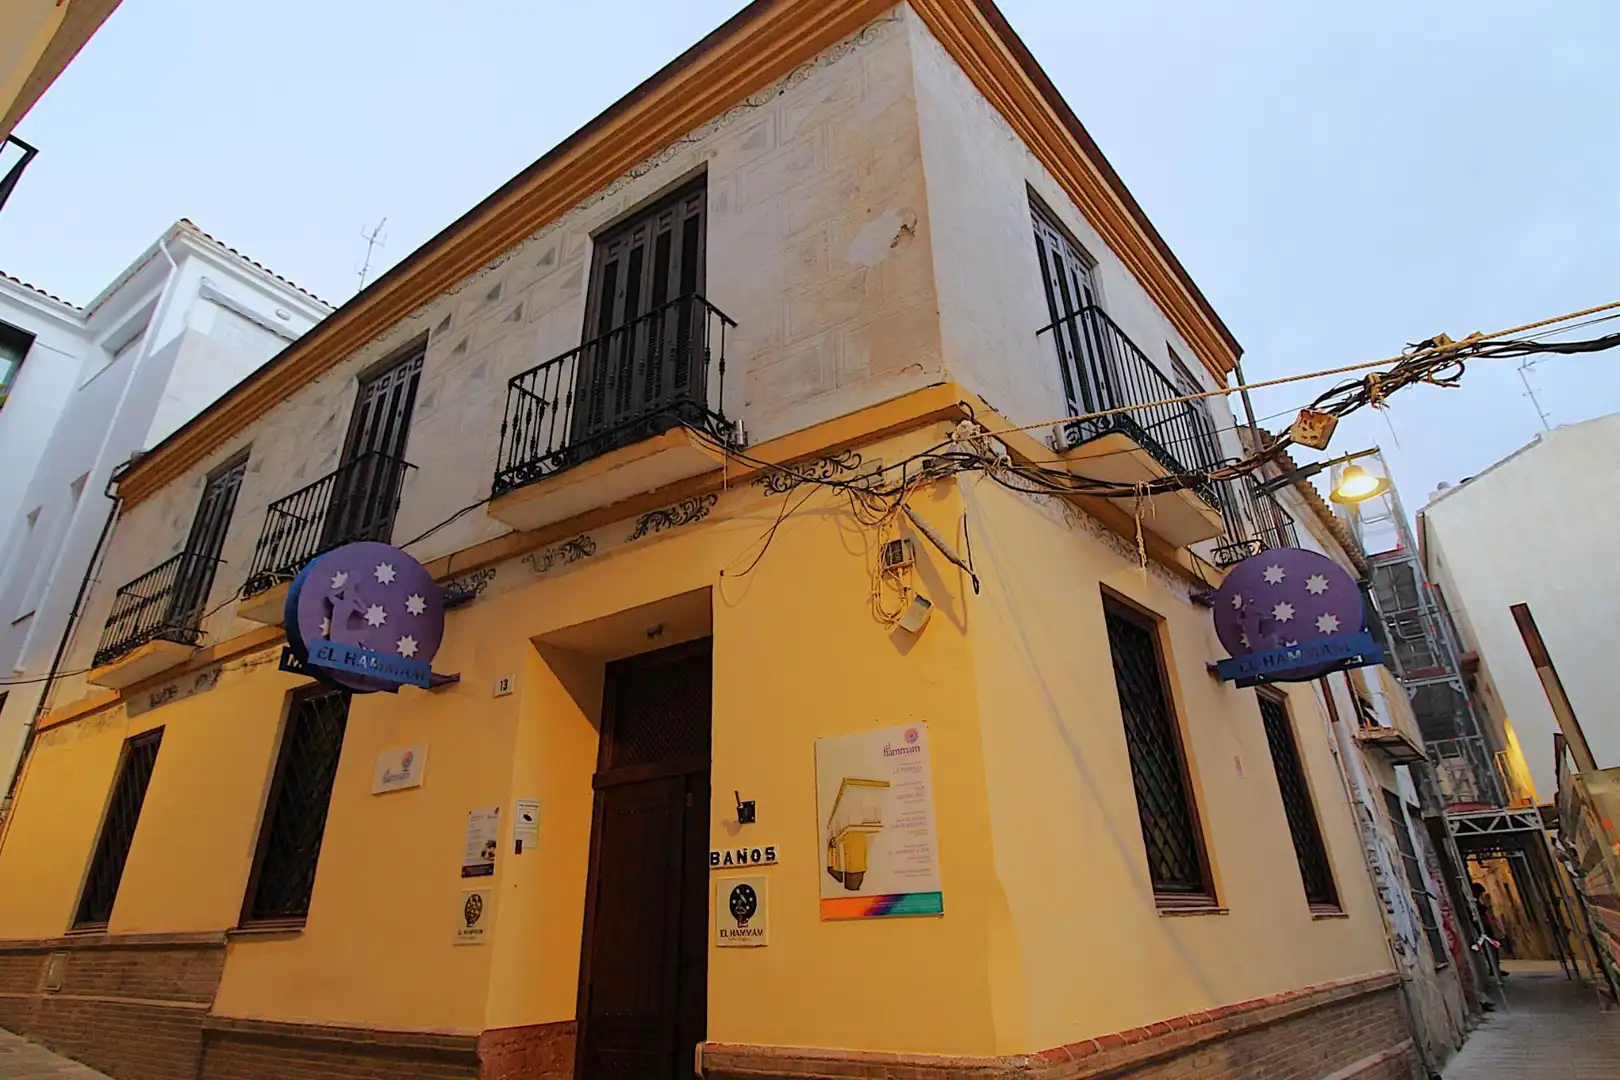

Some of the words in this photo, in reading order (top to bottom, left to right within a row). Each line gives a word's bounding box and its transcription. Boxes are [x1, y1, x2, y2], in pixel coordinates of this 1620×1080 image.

[317, 646, 338, 662] EL
[1239, 660, 1259, 673] EL
[500, 678, 509, 692] 13
[710, 846, 776, 866] BAÑOS
[720, 929, 729, 938] EL
